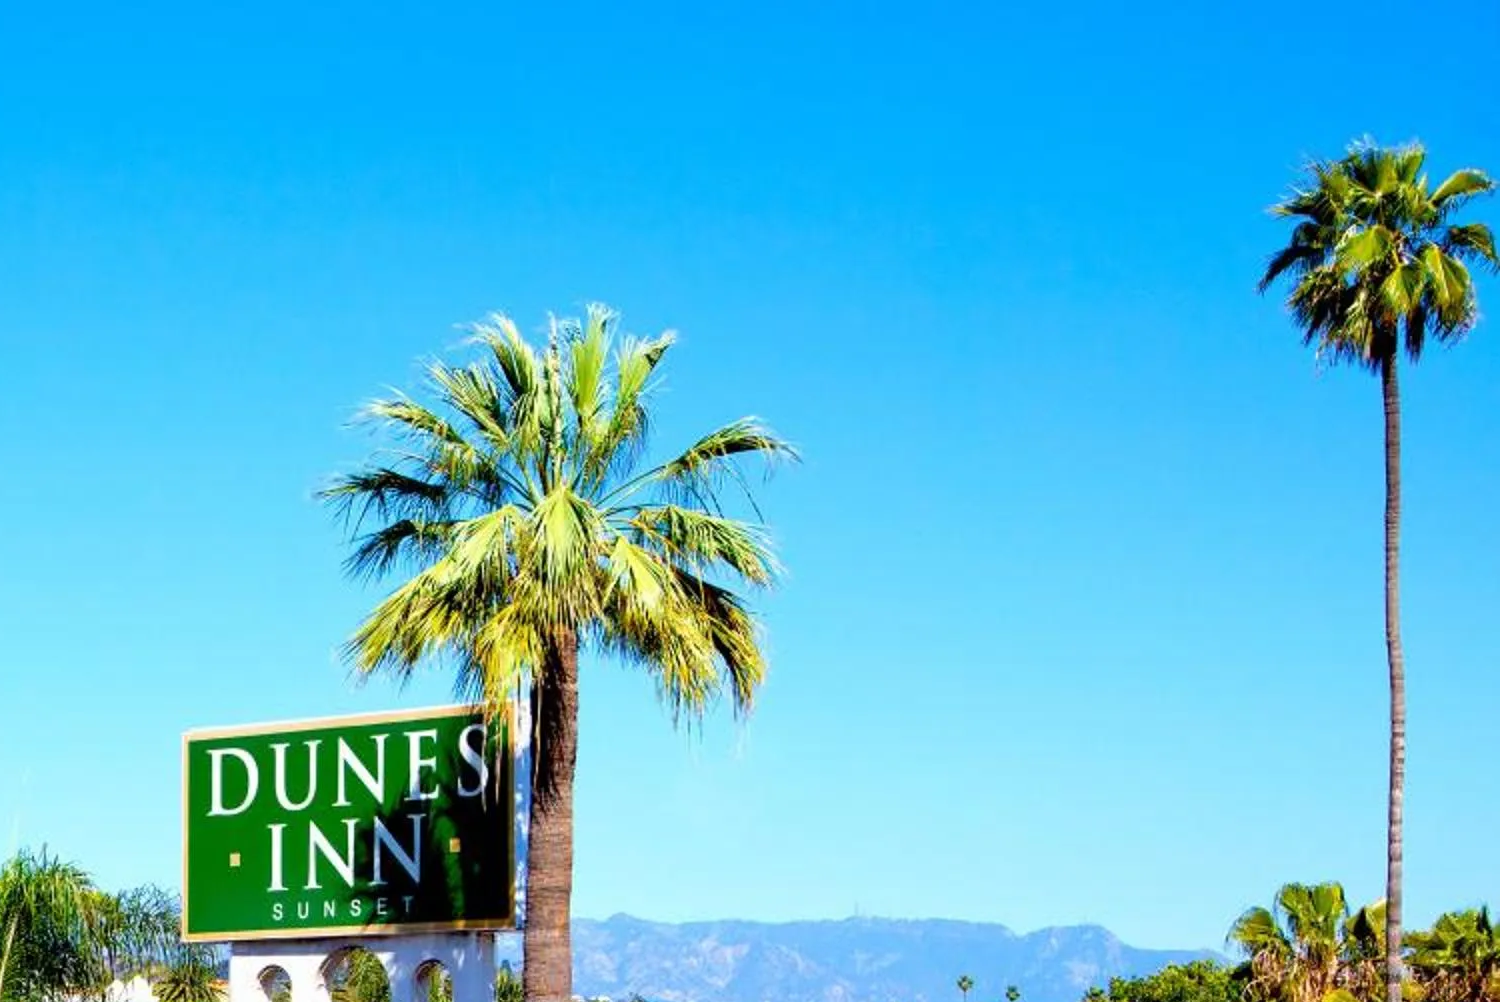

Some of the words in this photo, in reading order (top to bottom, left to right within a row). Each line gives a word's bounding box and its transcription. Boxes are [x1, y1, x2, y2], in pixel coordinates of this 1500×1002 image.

[206, 723, 489, 817] DUNES
[266, 813, 426, 892] INN
[272, 895, 415, 921] SUNSET
